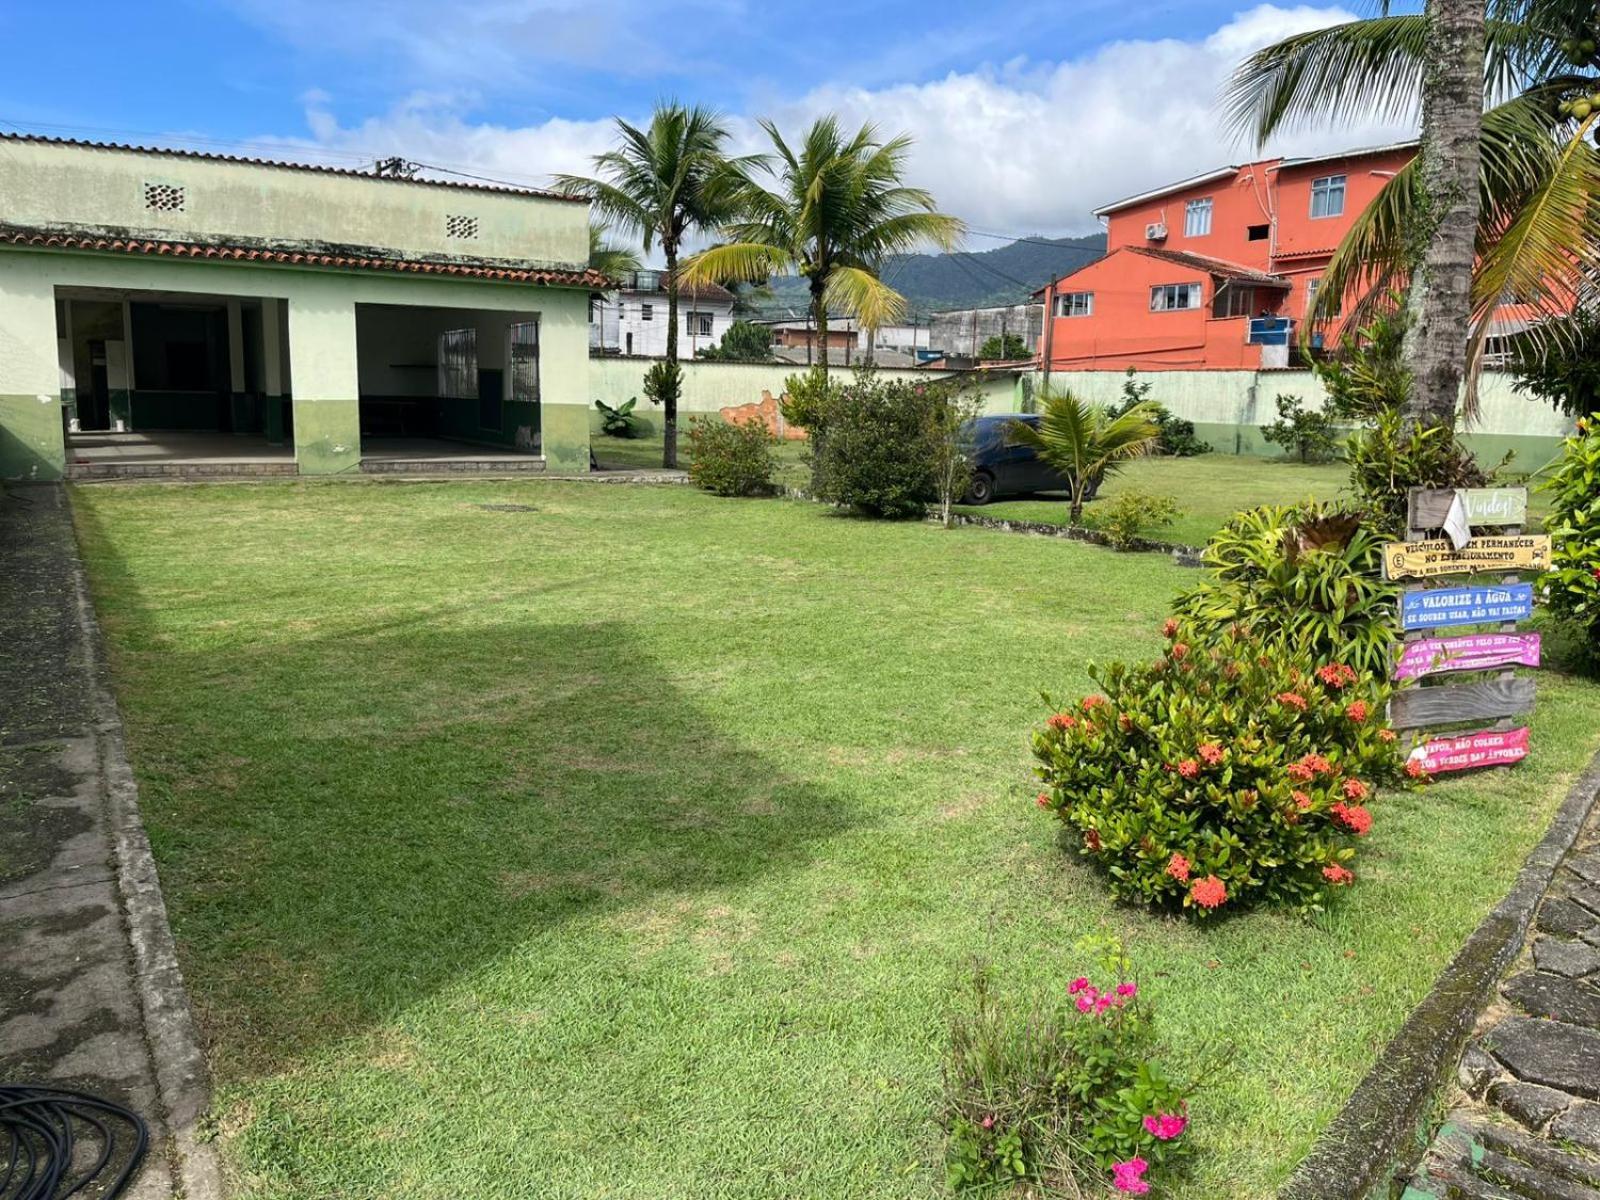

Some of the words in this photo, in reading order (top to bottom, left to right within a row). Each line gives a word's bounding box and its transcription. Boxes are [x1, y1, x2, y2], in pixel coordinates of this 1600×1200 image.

[1425, 554, 1437, 563] NO
[1422, 593, 1471, 609] VALORIZE
[1475, 593, 1482, 605] A
[1485, 589, 1511, 604] ÁGUA
[1407, 614, 1417, 623] SE
[1488, 607, 1500, 616] VAI
[1455, 737, 1471, 750] NÃO
